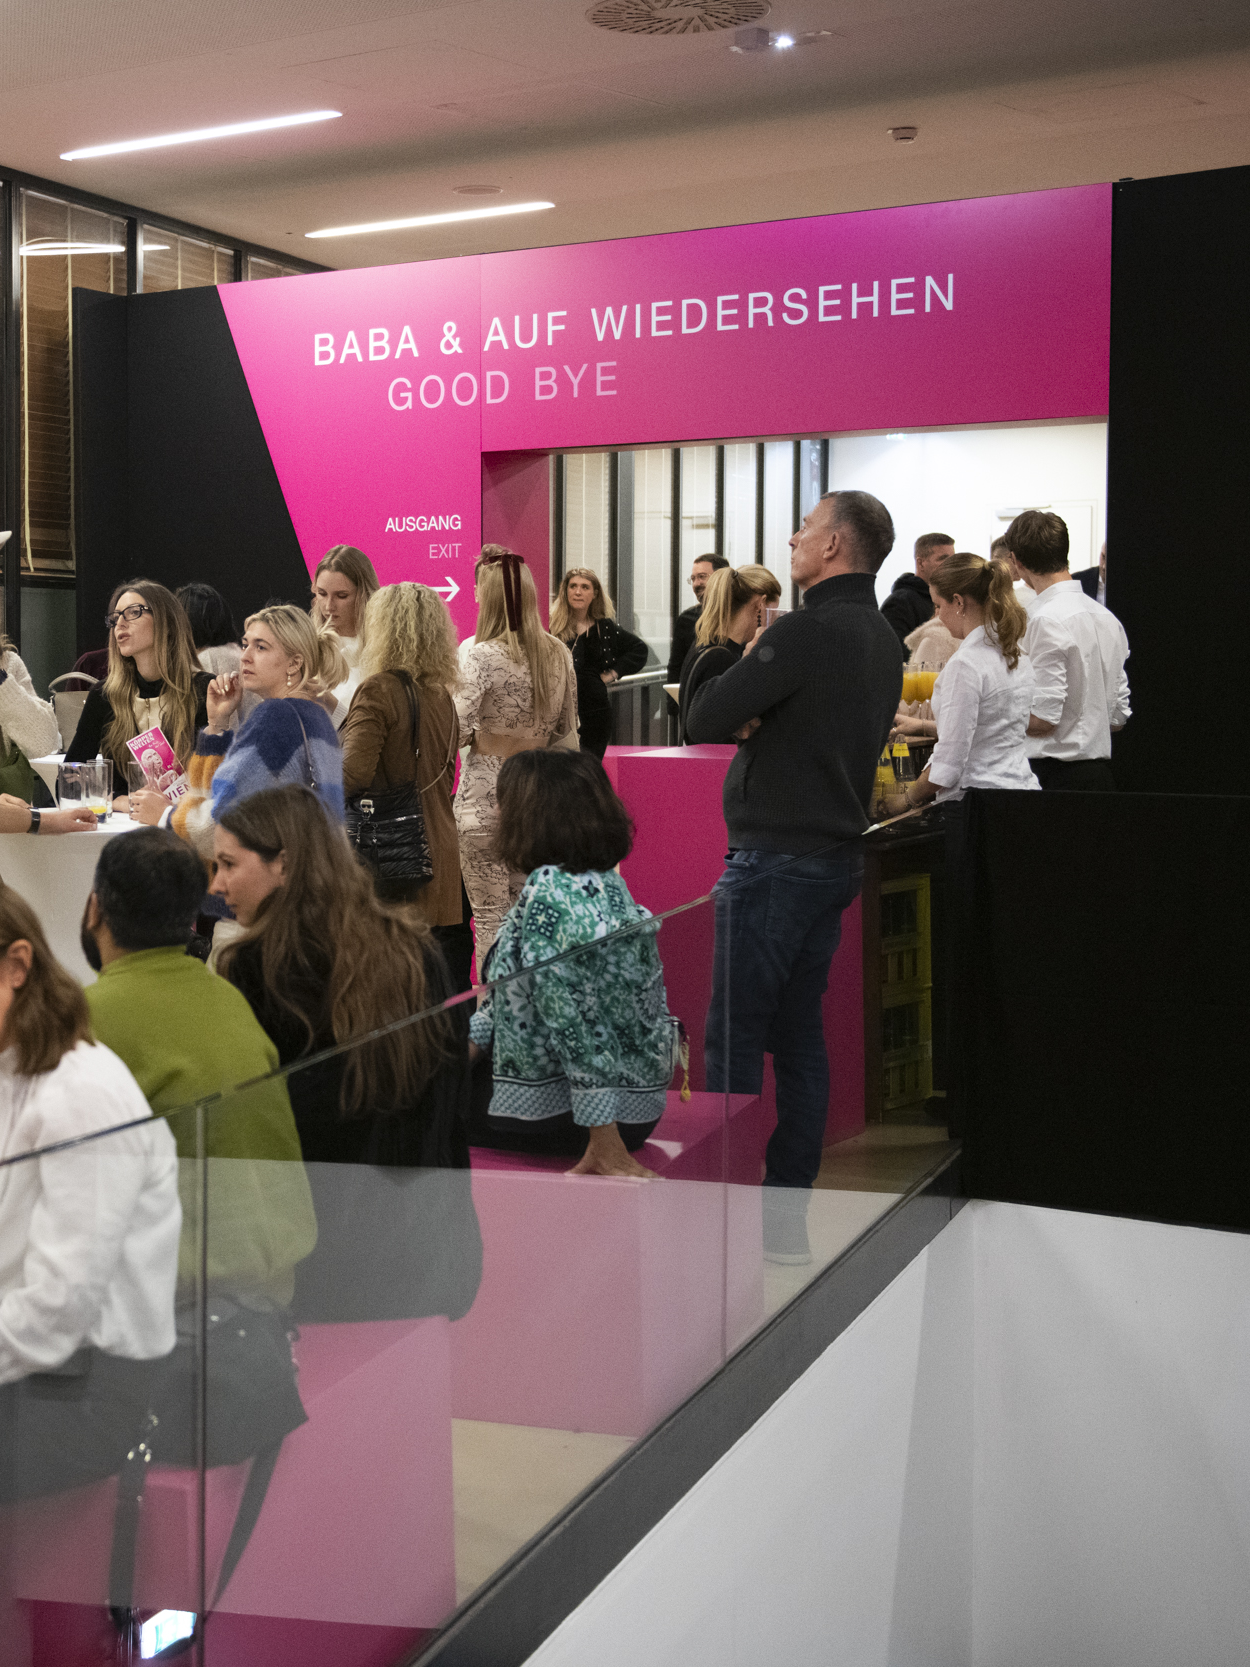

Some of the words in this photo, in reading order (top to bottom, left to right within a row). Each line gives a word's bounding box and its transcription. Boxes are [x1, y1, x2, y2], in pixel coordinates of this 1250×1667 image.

[314, 324, 419, 366] BABA
[439, 321, 463, 355] &
[483, 310, 567, 353] AUF
[591, 273, 955, 341] WIEDERSEHEN
[387, 370, 510, 411] GOOD
[535, 361, 618, 400] BYE
[385, 514, 461, 532] AUSGANG
[429, 543, 462, 559] EXIT
